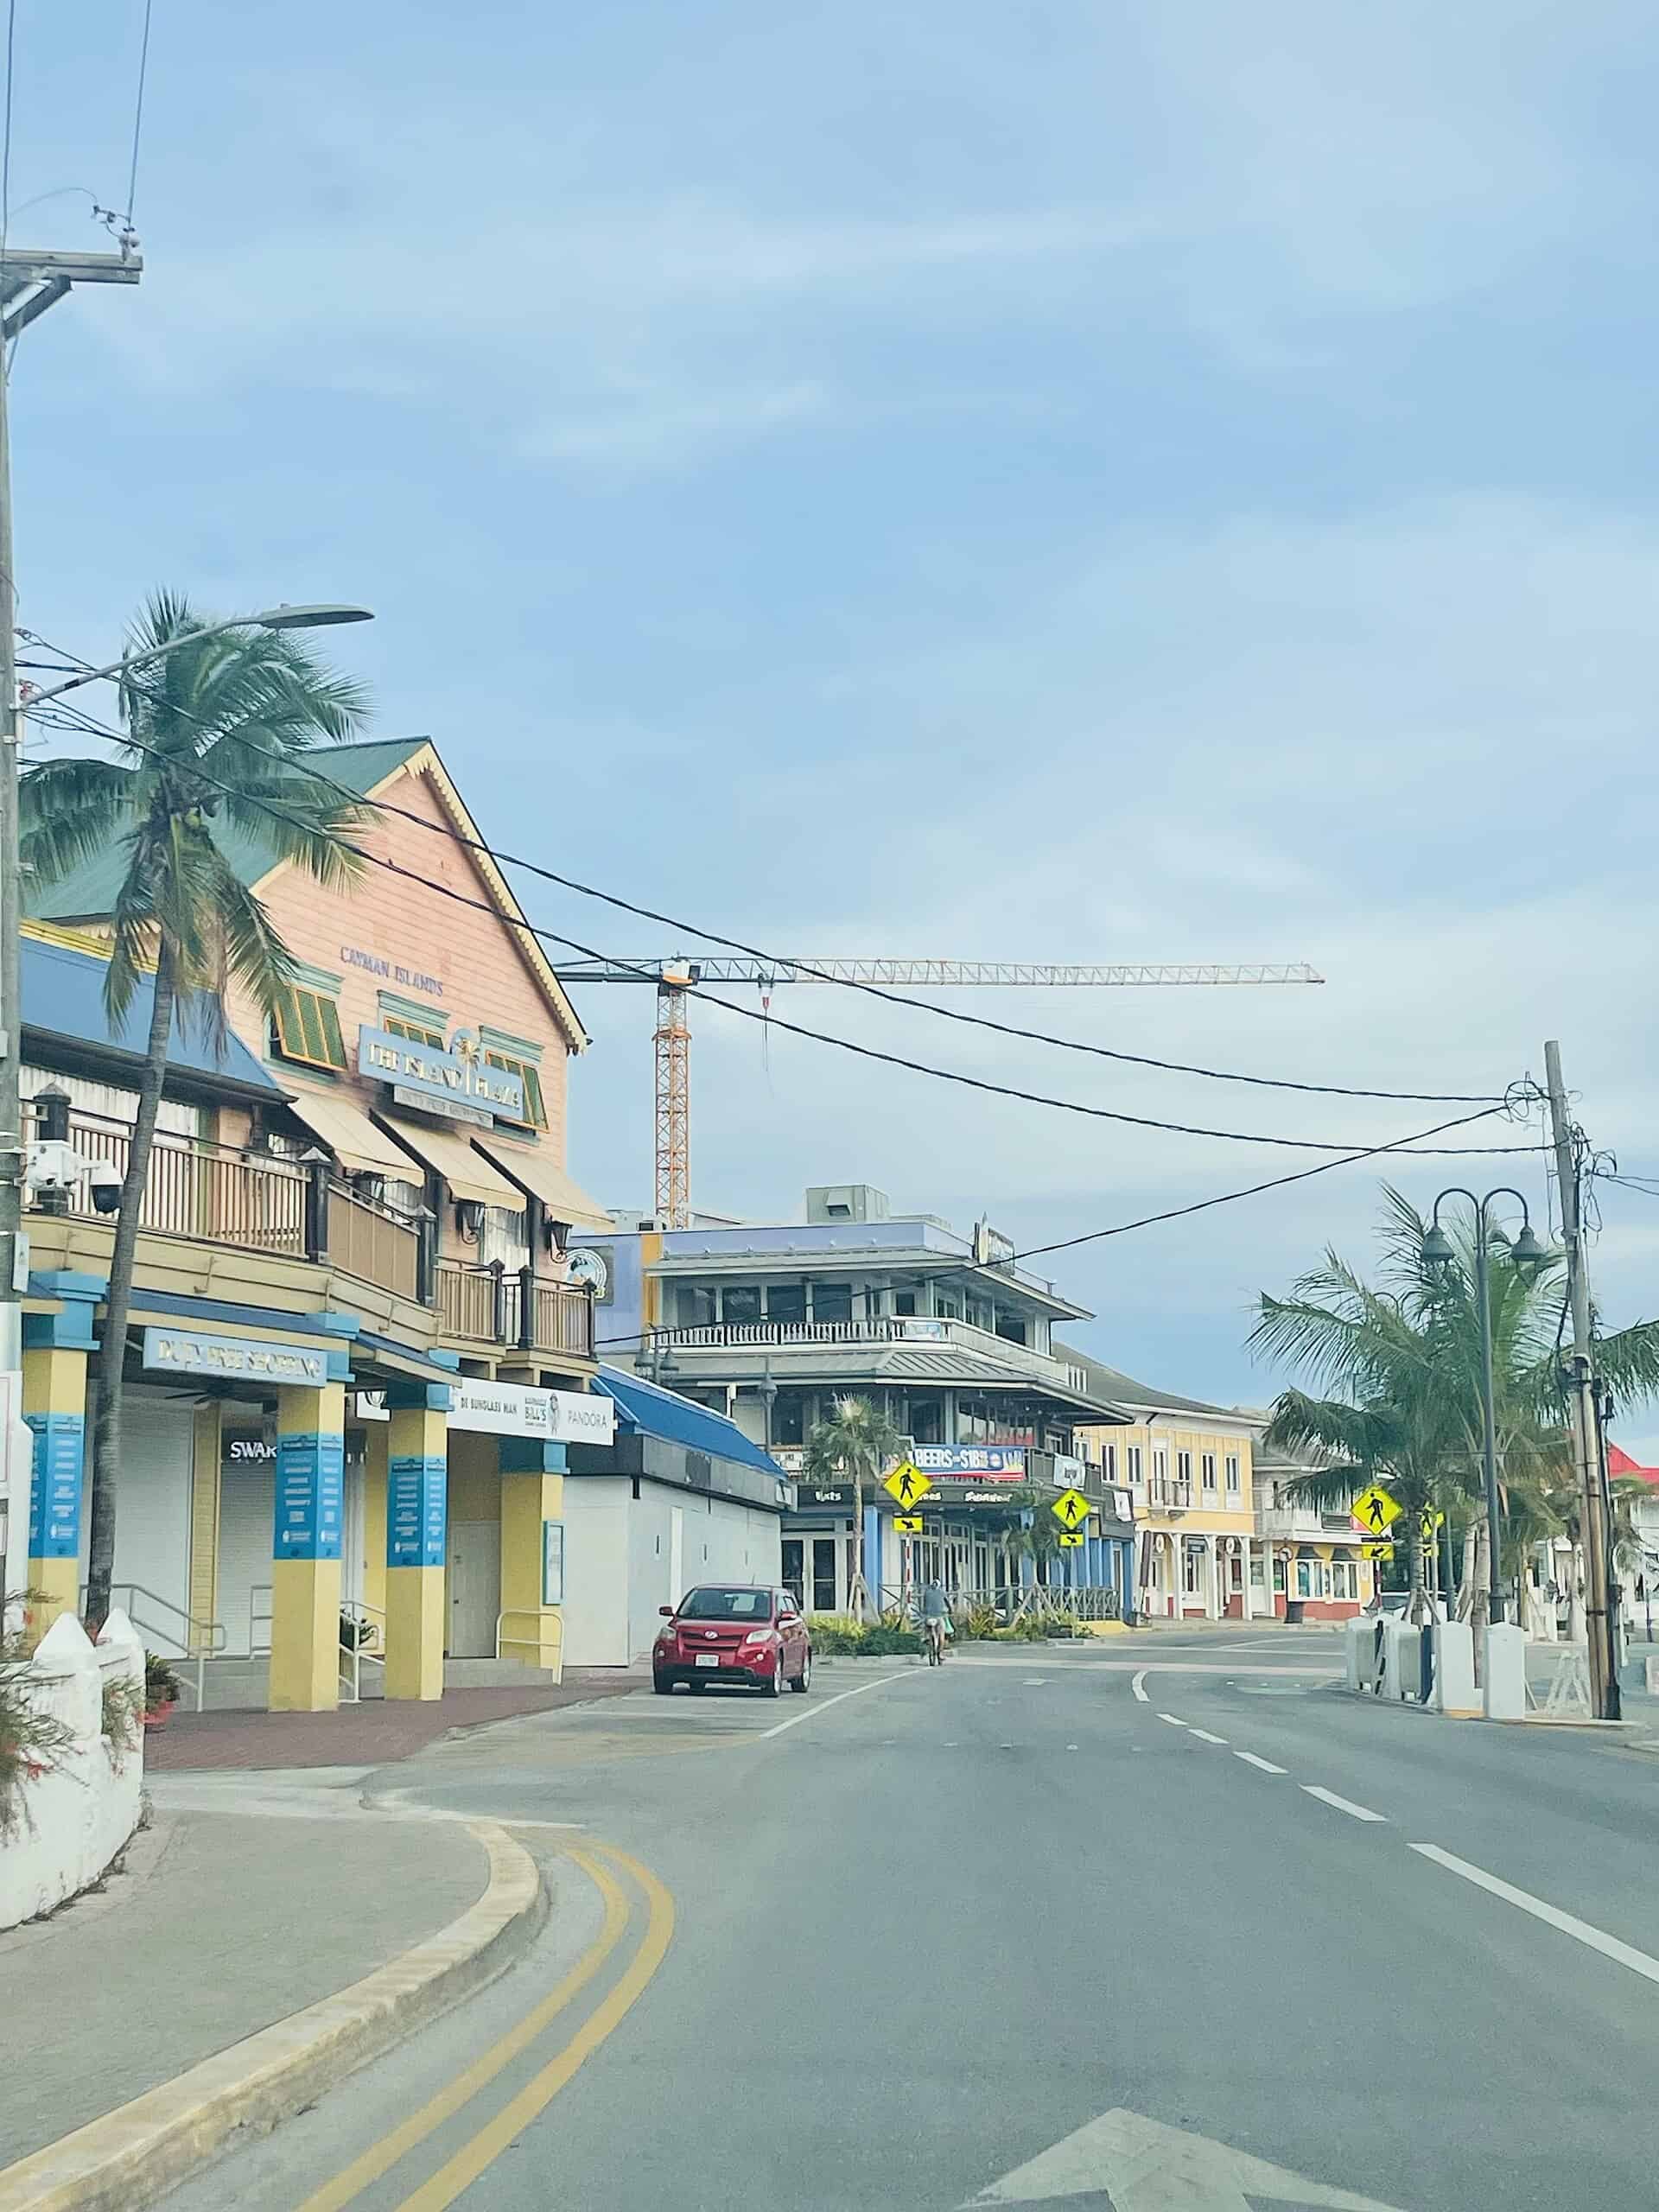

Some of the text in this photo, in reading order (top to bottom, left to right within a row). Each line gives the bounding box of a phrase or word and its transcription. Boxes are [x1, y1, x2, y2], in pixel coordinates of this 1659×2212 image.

[340, 946, 443, 997] CAYMAN ISLANDS
[369, 1043, 398, 1071] THE
[403, 1053, 462, 1090] ISLAND
[158, 1339, 321, 1378] DUTY FREE SHOPPING
[567, 1409, 608, 1428] PANDORA
